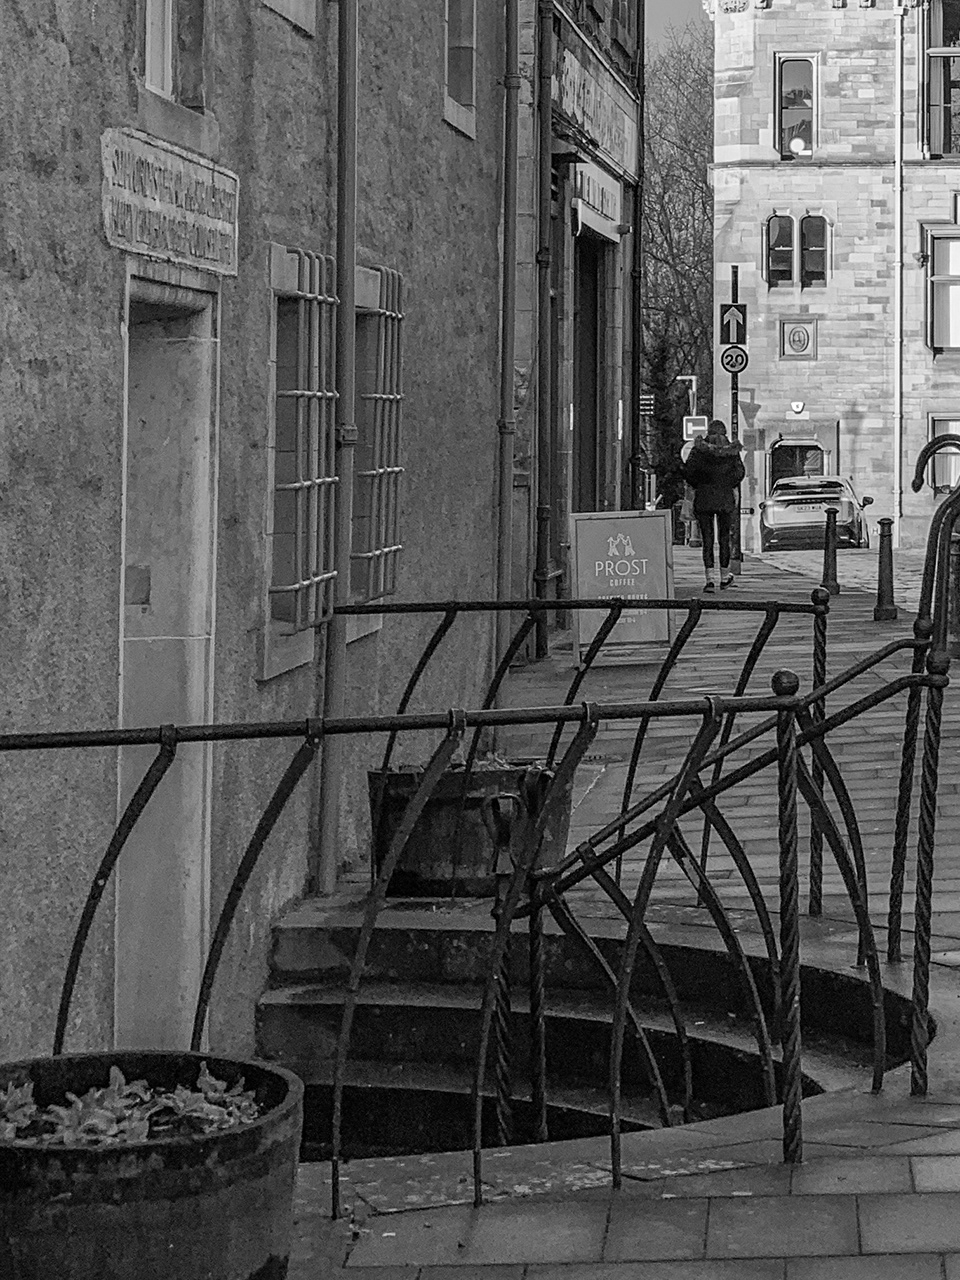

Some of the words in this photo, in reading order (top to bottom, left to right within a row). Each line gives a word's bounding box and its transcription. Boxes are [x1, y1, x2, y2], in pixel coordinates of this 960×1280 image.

[724, 353, 745, 368] 20
[594, 558, 649, 577] PROST
[609, 578, 635, 587] COFFEE
